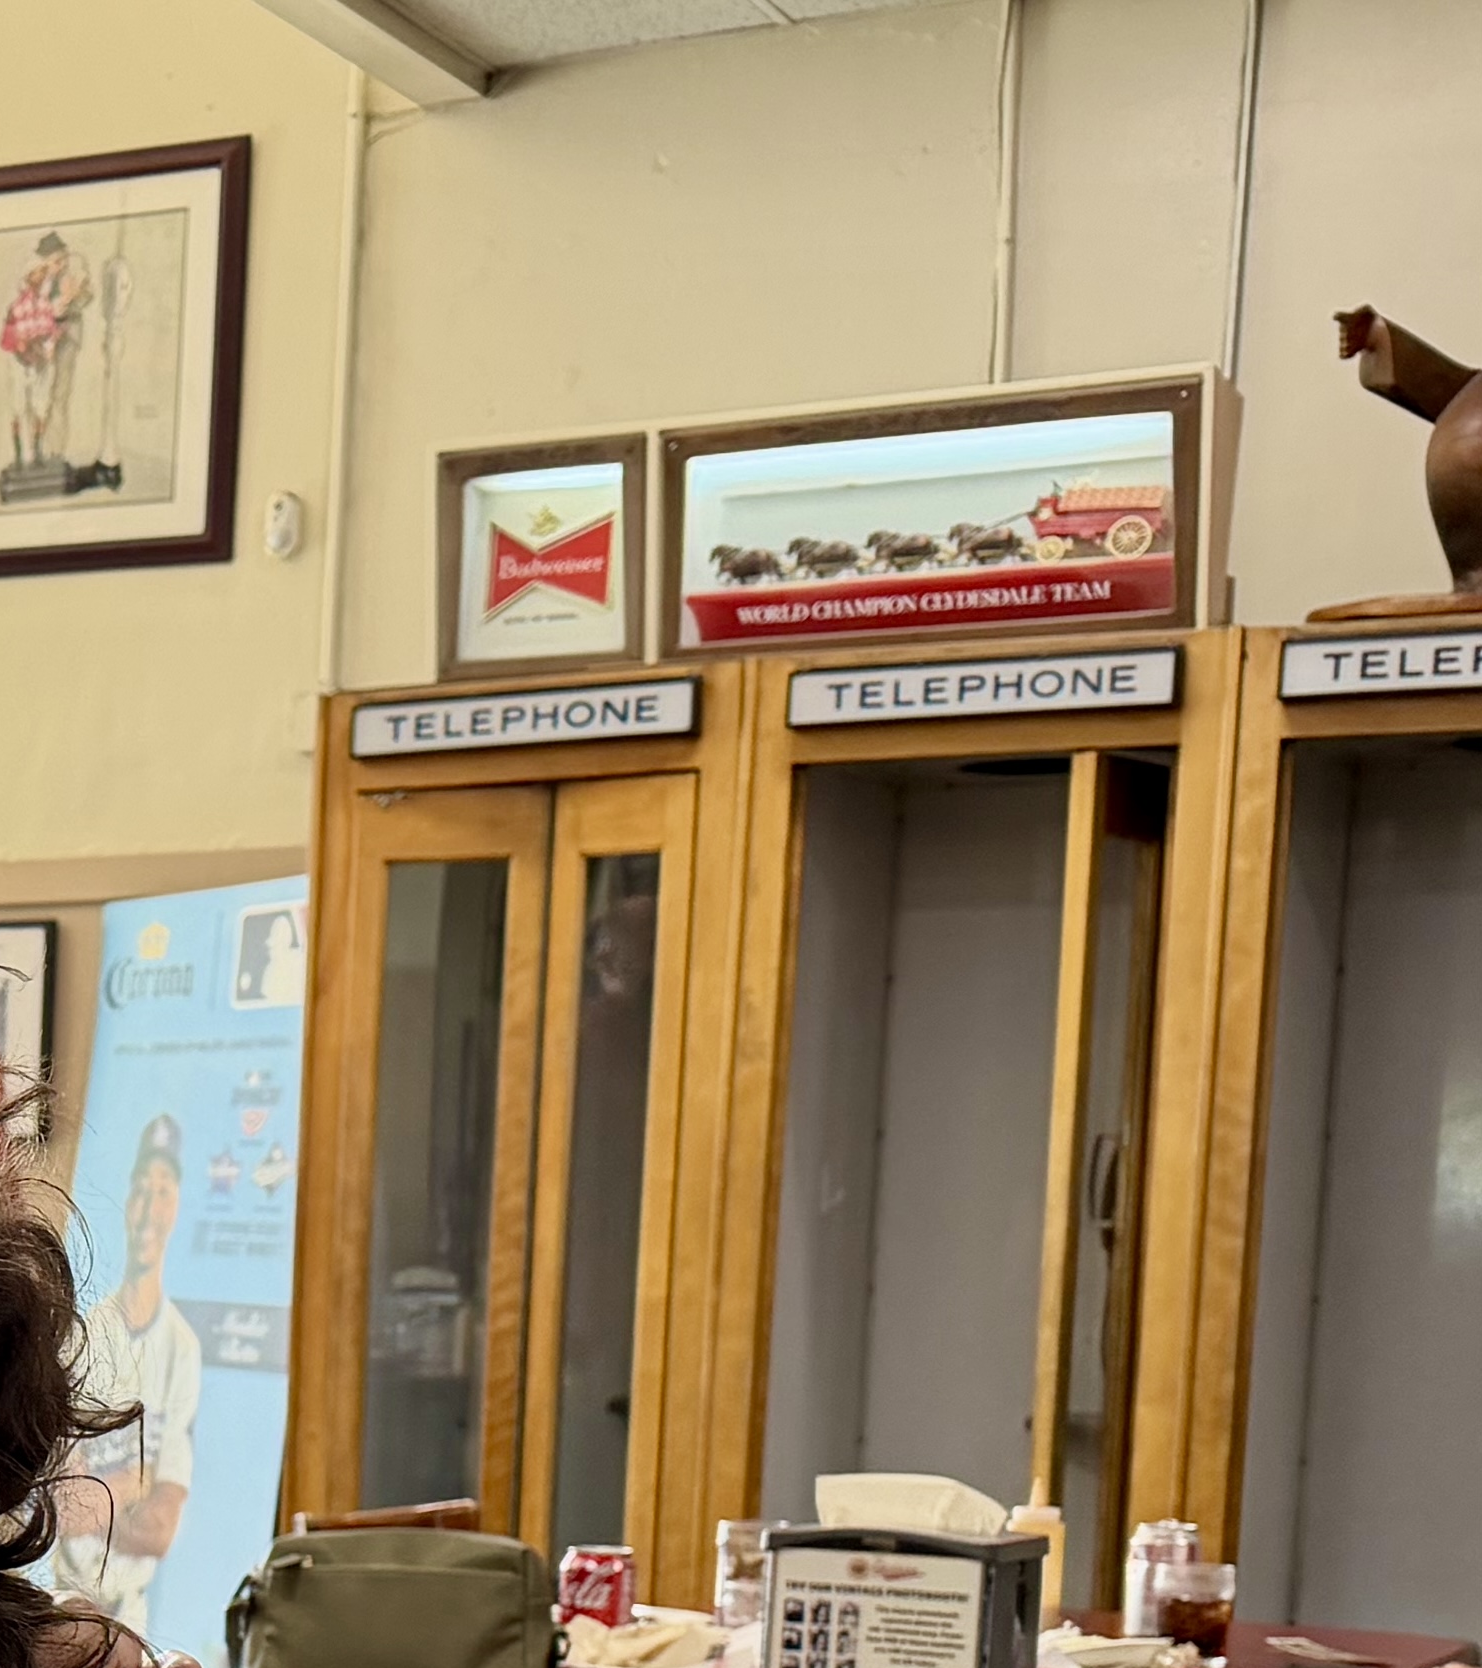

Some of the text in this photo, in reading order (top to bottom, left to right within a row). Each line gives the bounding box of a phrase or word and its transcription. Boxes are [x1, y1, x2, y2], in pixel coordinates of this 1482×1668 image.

[737, 580, 1111, 626] WORLD CHAMPION CLYDESDALE TEAM
[827, 665, 1139, 711] TELEPHONE
[386, 695, 660, 743] TELEPHONE
